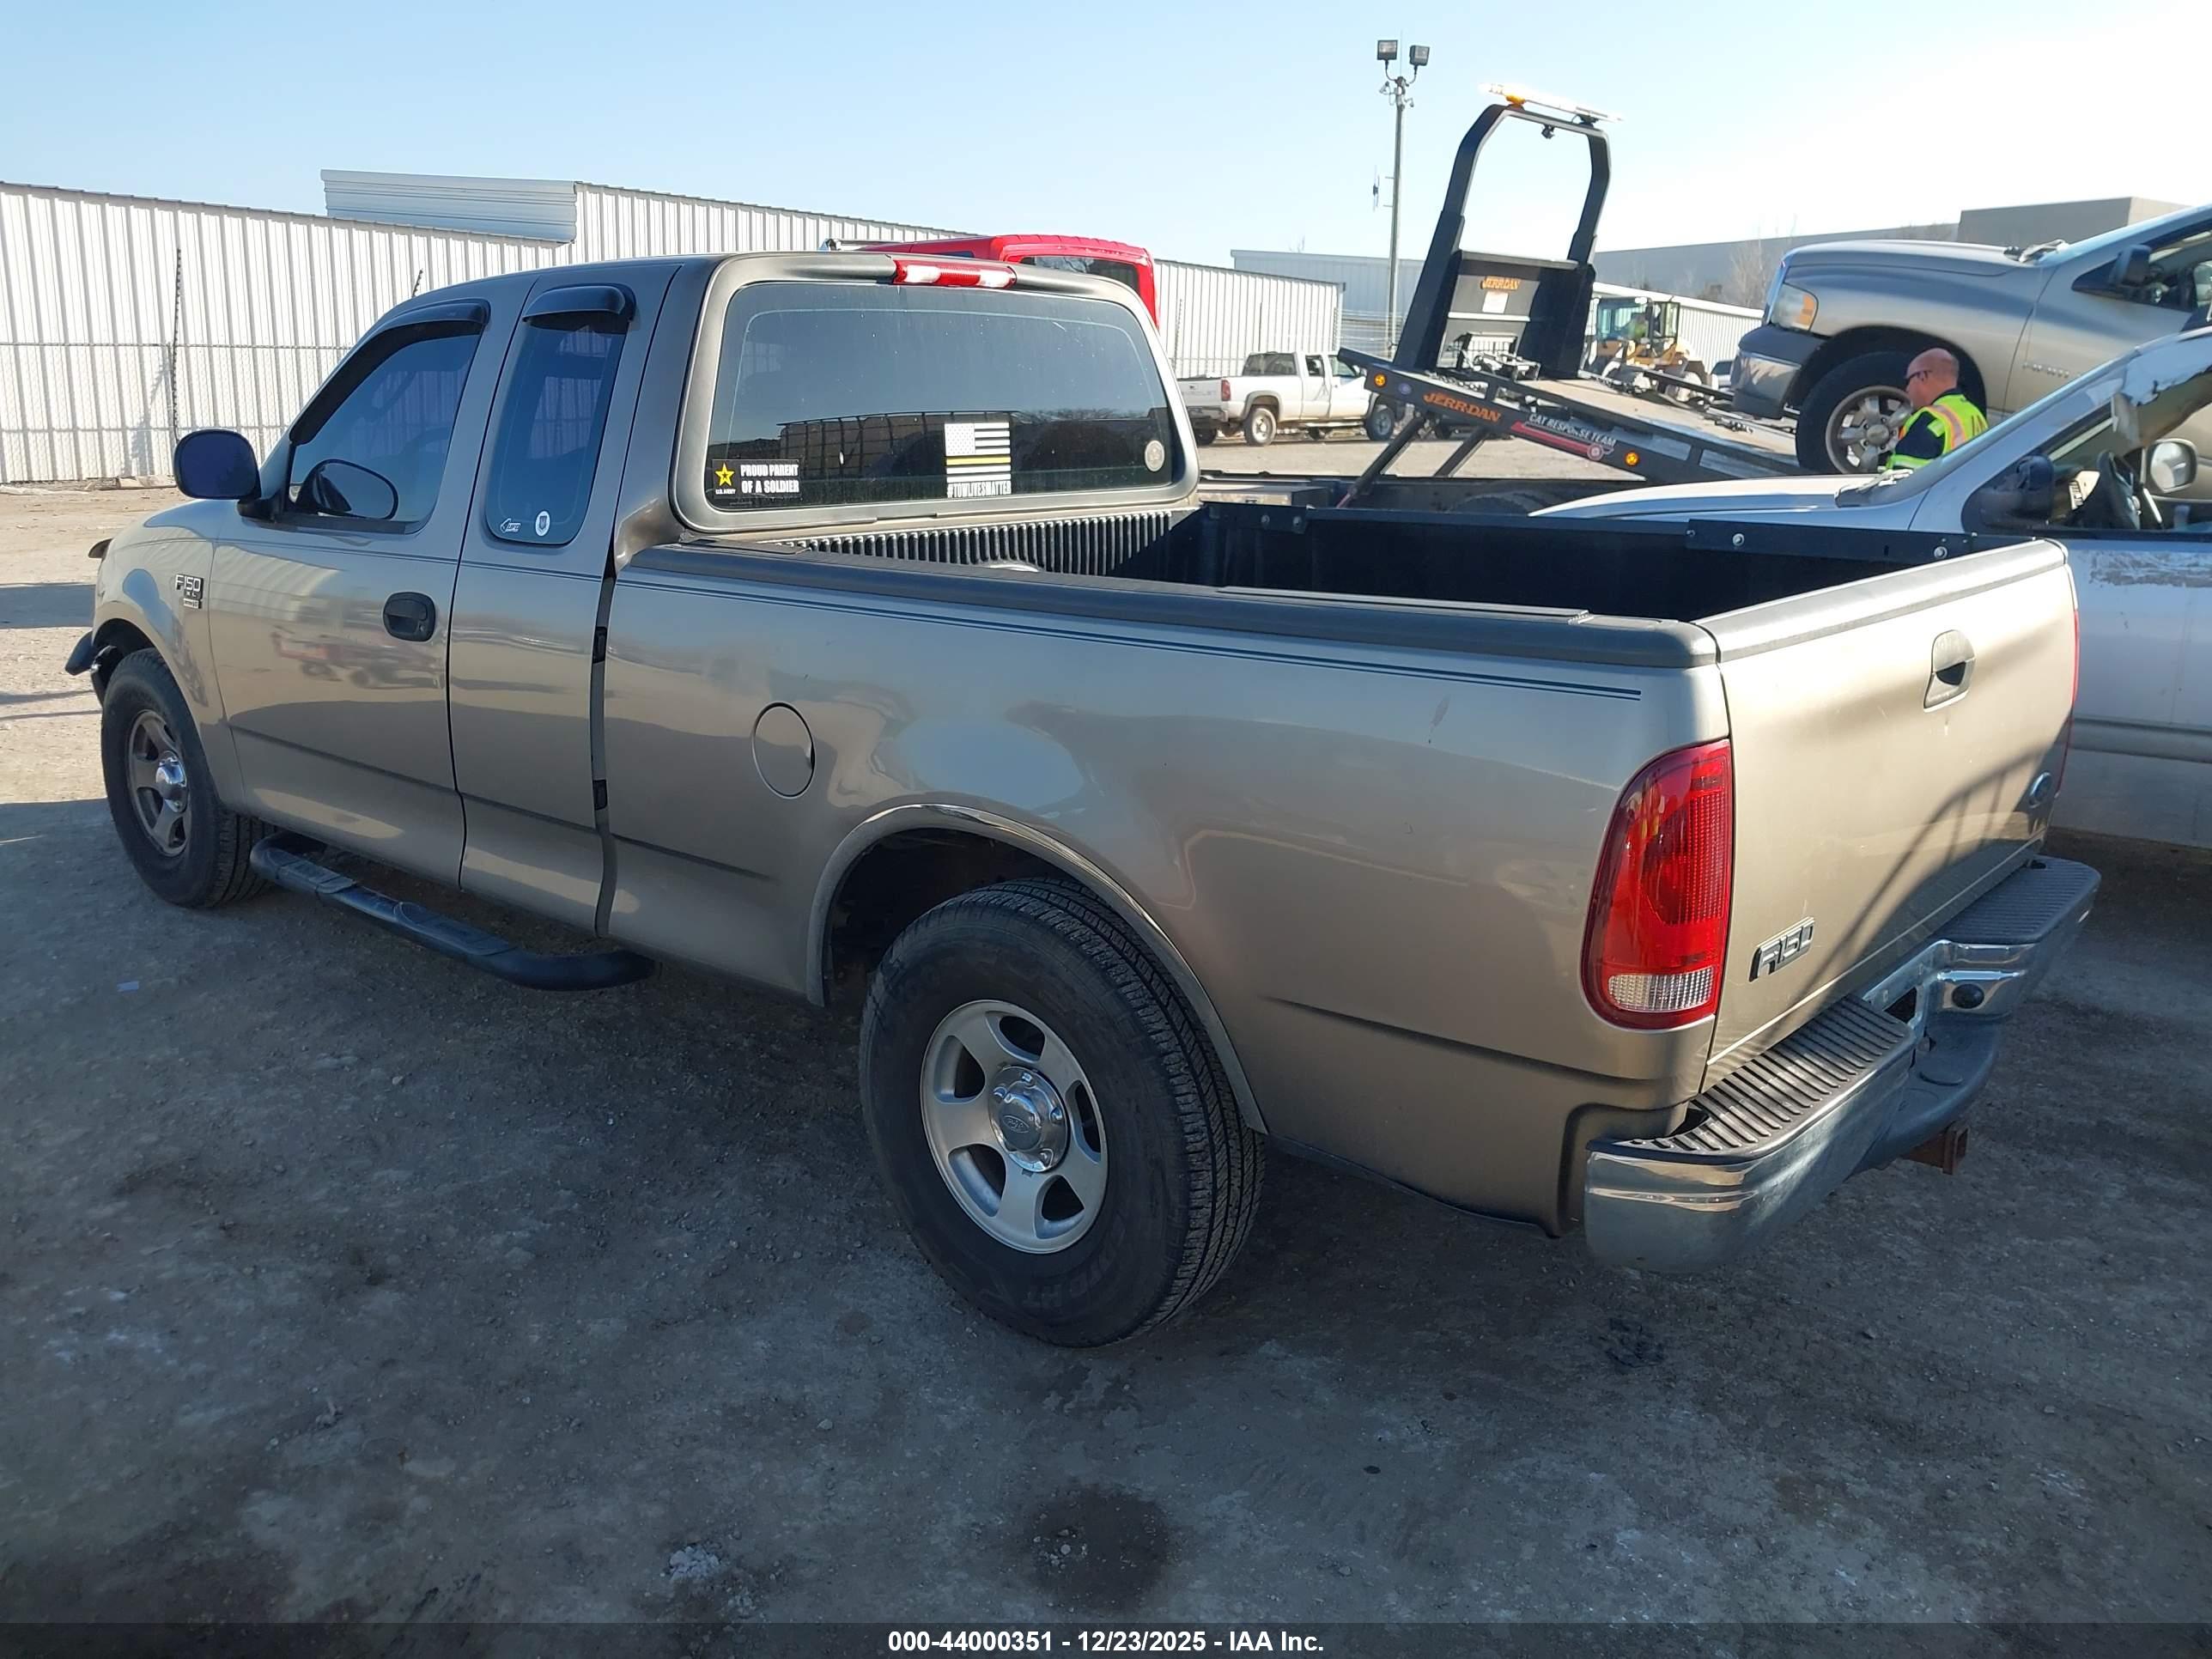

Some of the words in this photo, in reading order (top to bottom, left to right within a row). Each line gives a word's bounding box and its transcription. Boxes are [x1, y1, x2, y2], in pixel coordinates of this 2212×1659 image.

[1528, 414, 1547, 426] CAT
[1591, 431, 1617, 447] TEAM
[740, 464, 769, 477] PROUD
[769, 464, 799, 477] PARENT
[741, 480, 753, 494] OF
[755, 480, 763, 494] A
[763, 480, 799, 493] SOLDIER
